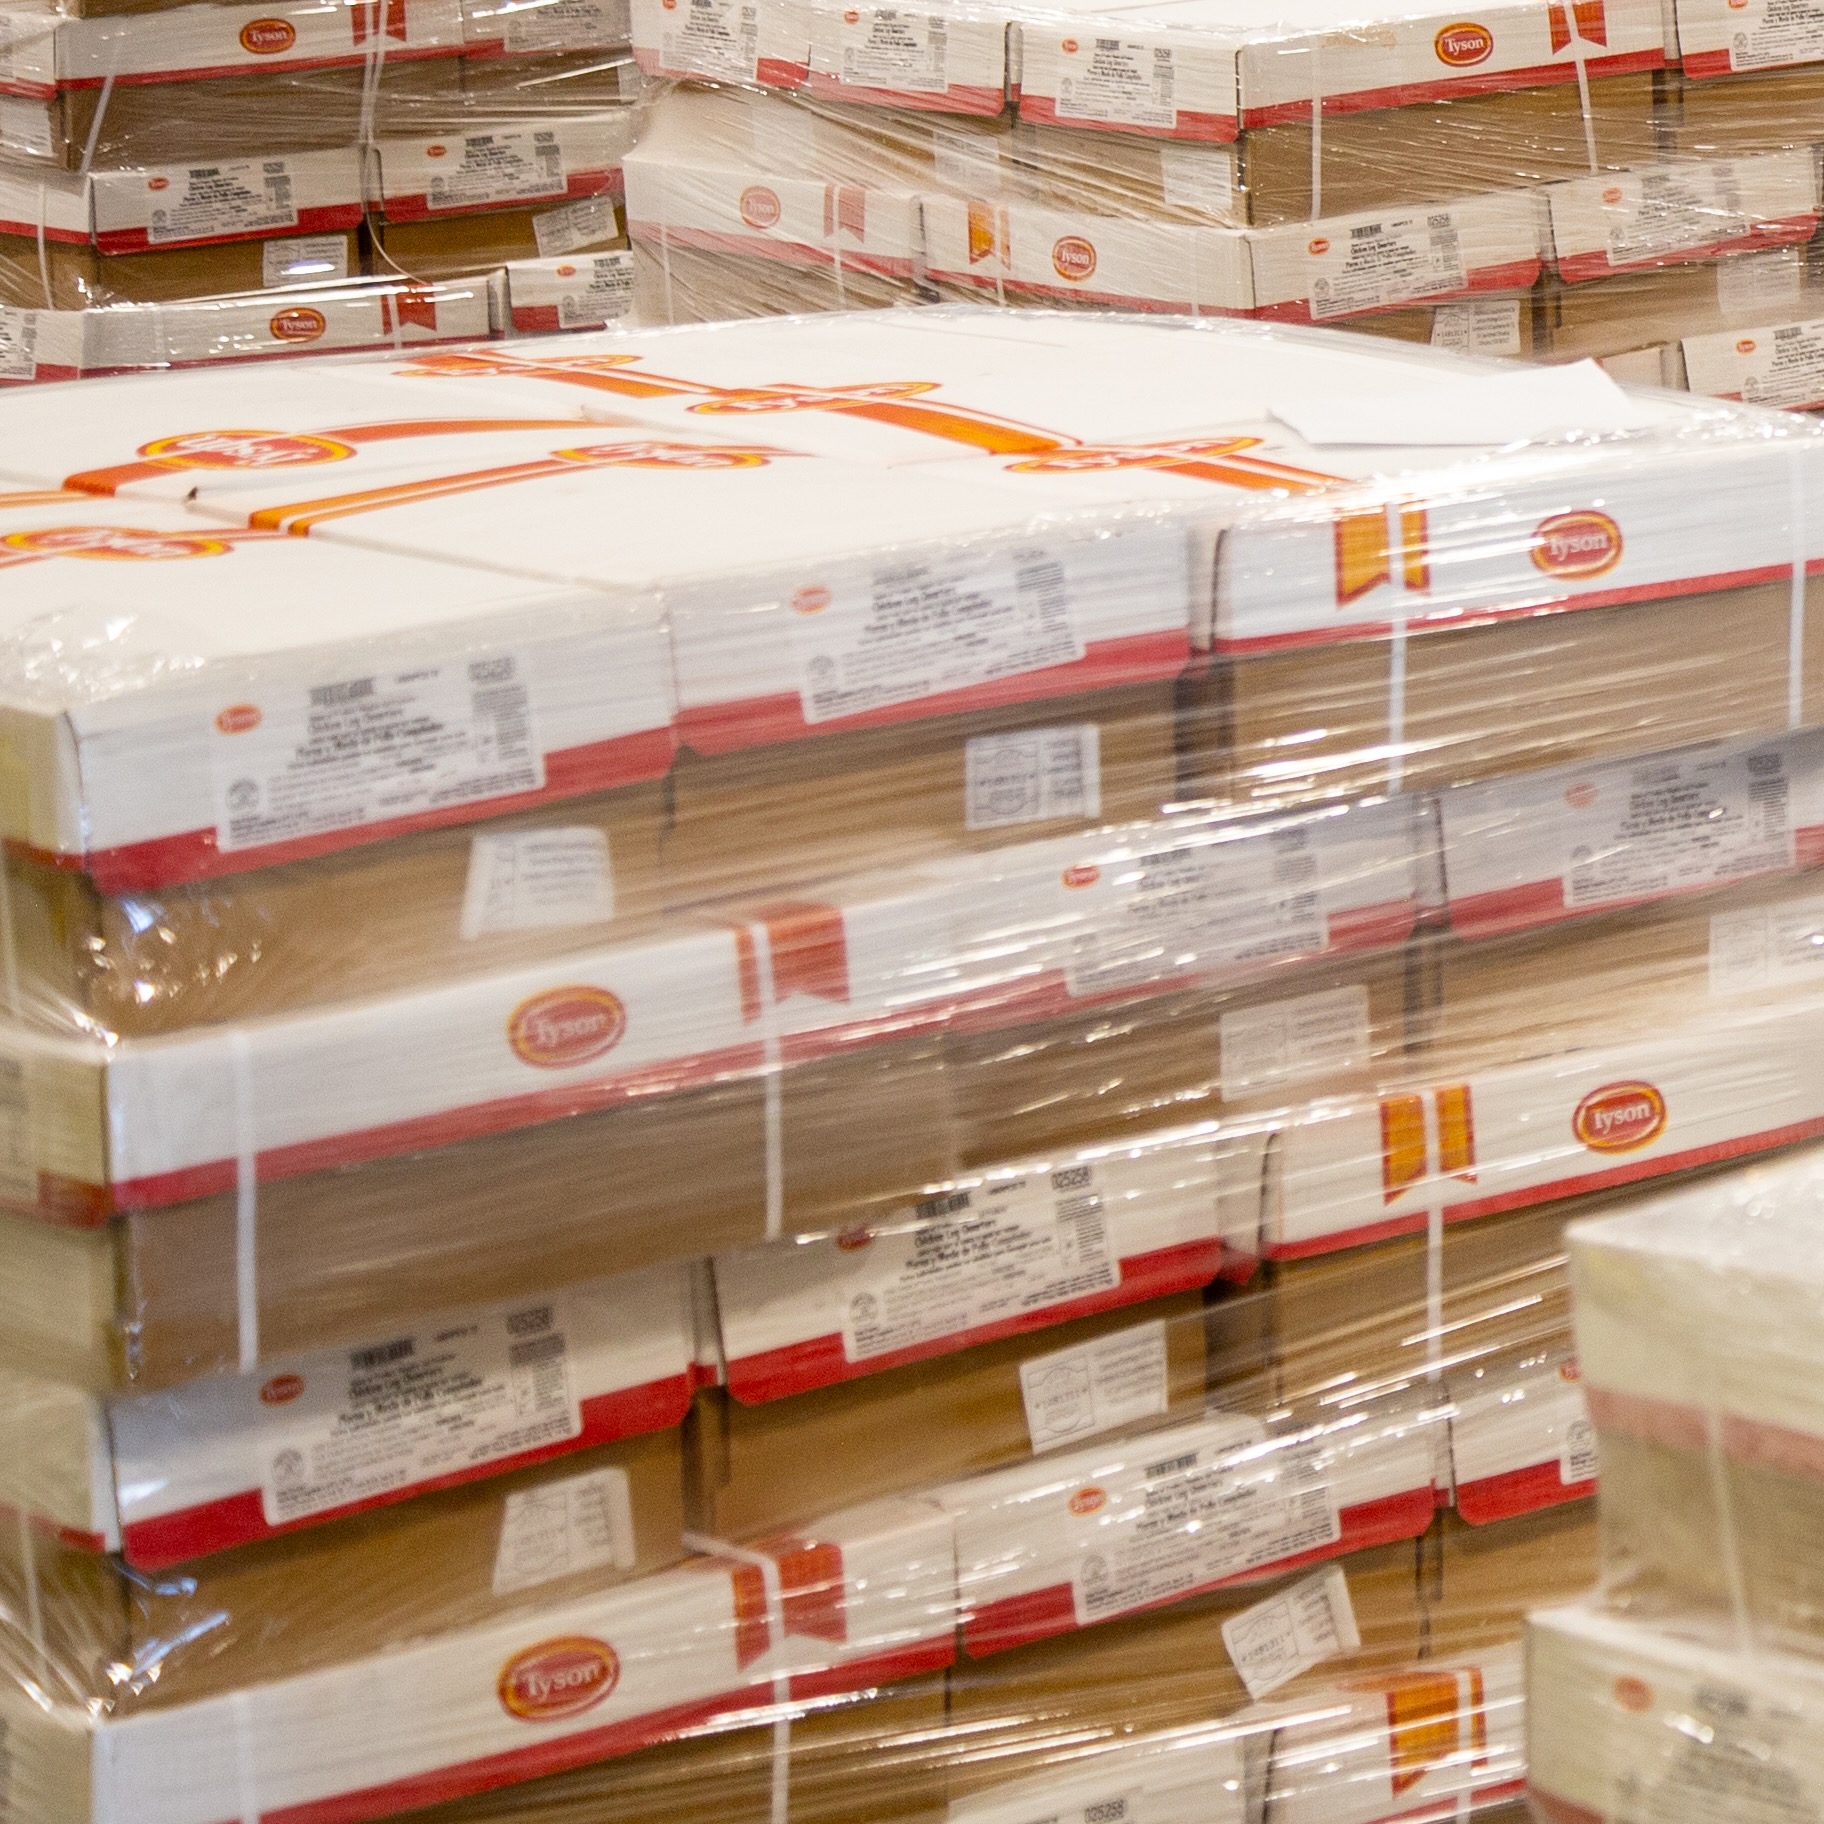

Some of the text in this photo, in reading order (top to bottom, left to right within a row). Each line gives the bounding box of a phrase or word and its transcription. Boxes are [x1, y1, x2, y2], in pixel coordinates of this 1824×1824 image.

[250, 29, 289, 46] Tyson
[1446, 36, 1484, 57] Tyson
[282, 317, 318, 333] Tyson
[1549, 536, 1612, 563] Tyson
[531, 1010, 612, 1047] Tyson
[1592, 1107, 1650, 1138] Tyson
[522, 1662, 604, 1701] Tyson
